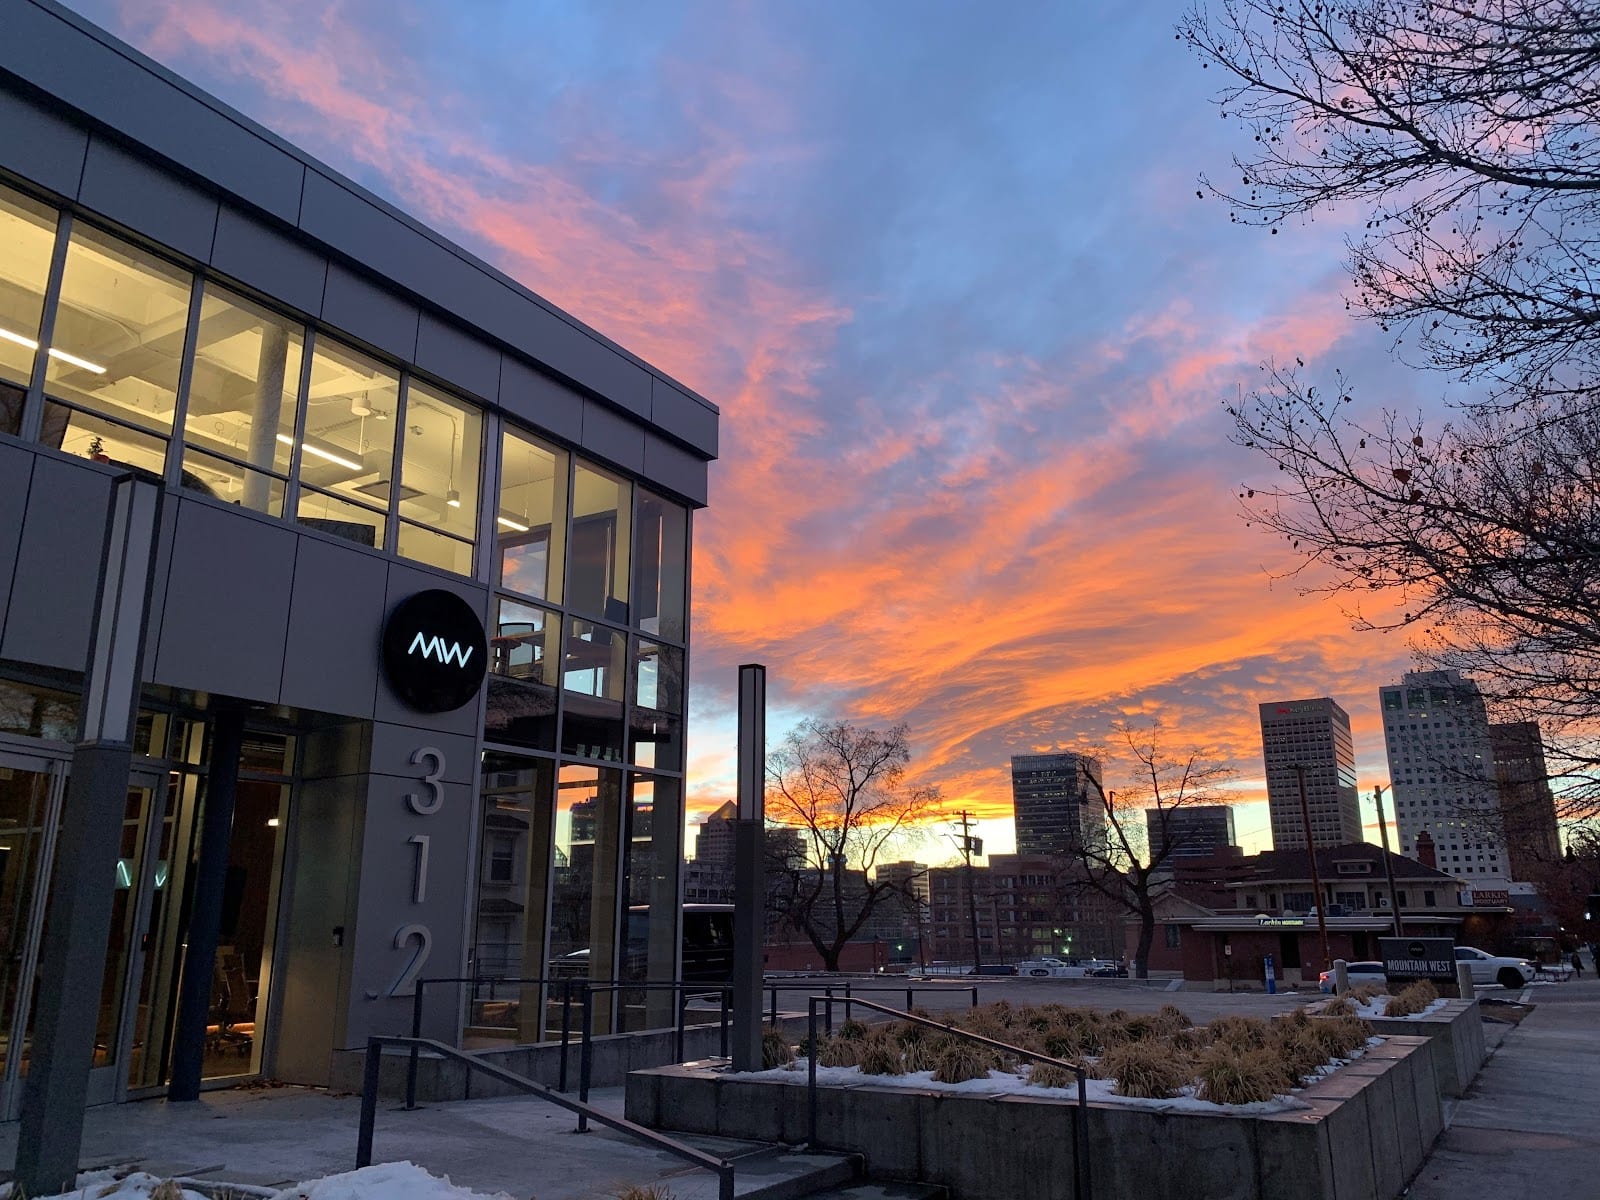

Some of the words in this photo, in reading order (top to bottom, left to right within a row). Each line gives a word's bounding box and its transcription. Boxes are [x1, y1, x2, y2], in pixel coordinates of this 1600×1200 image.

[407, 631, 474, 669] MW
[1473, 891, 1508, 899] LARKIN
[1387, 960, 1428, 971] MOUNTAIN
[1429, 960, 1451, 972] WEST
